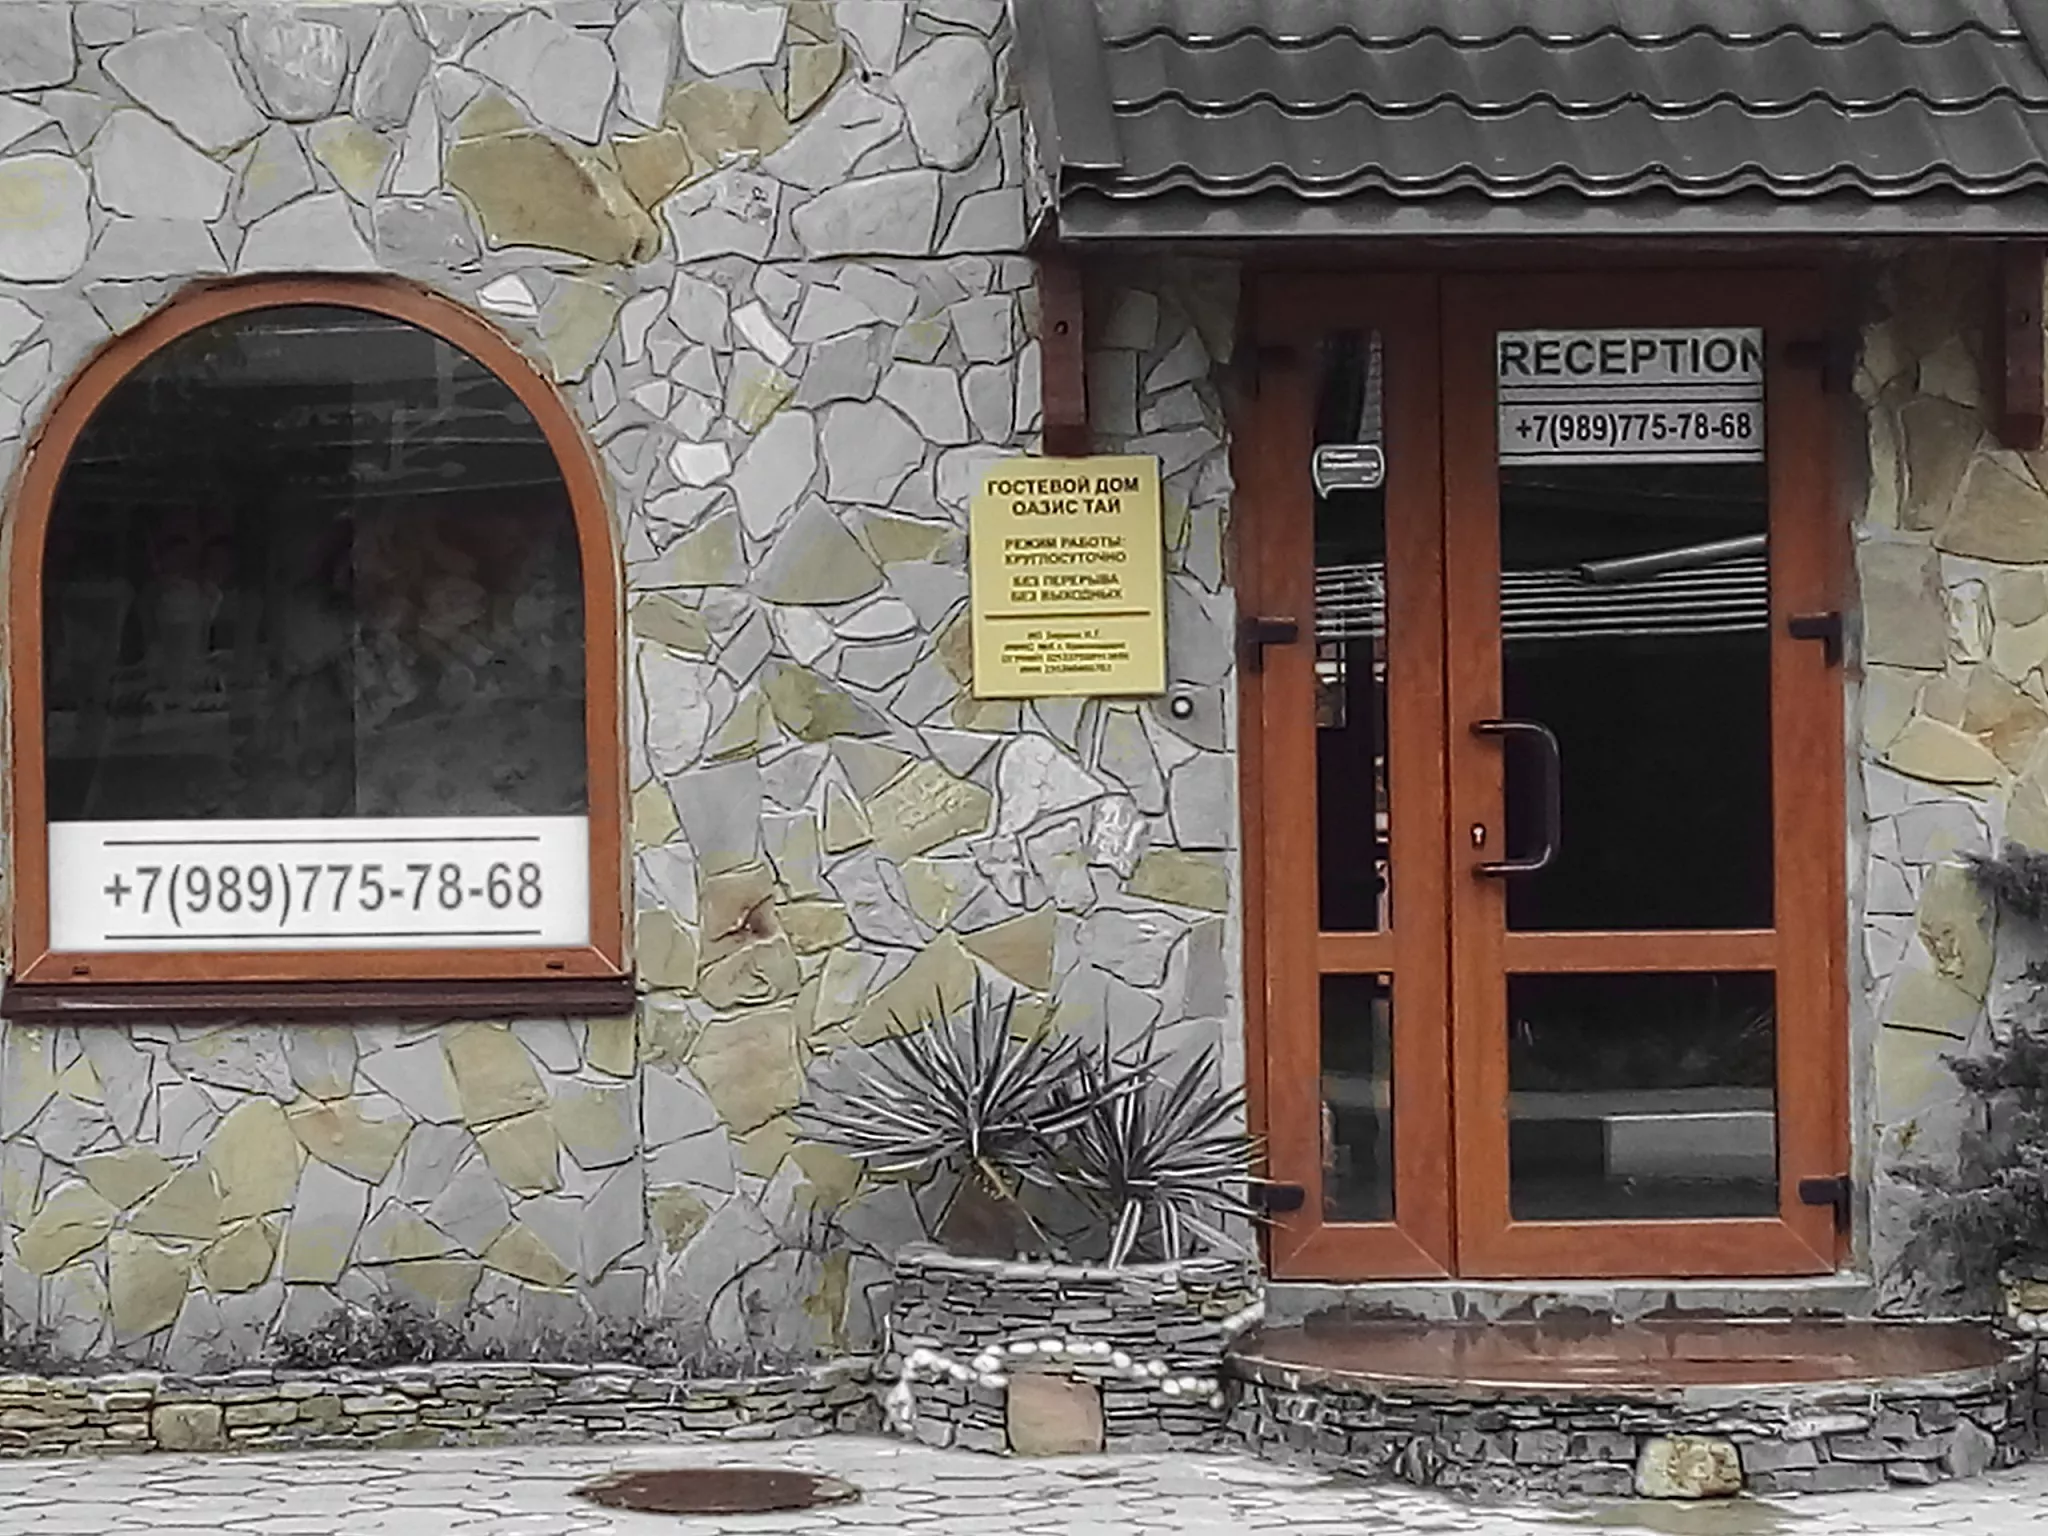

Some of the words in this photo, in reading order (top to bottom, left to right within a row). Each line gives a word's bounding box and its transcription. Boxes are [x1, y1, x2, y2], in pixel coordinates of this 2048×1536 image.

[1516, 412, 1752, 448] +7(989)775-78-68
[987, 476, 1090, 496] ГОСТЕВОЙ
[1095, 476, 1139, 494] ДОМ
[1012, 499, 1079, 516] ОАЗИС
[1083, 497, 1121, 514] ТАЙ
[1005, 537, 1057, 550] РЕЖИМ
[103, 861, 543, 927] +7(989)775-78-68
